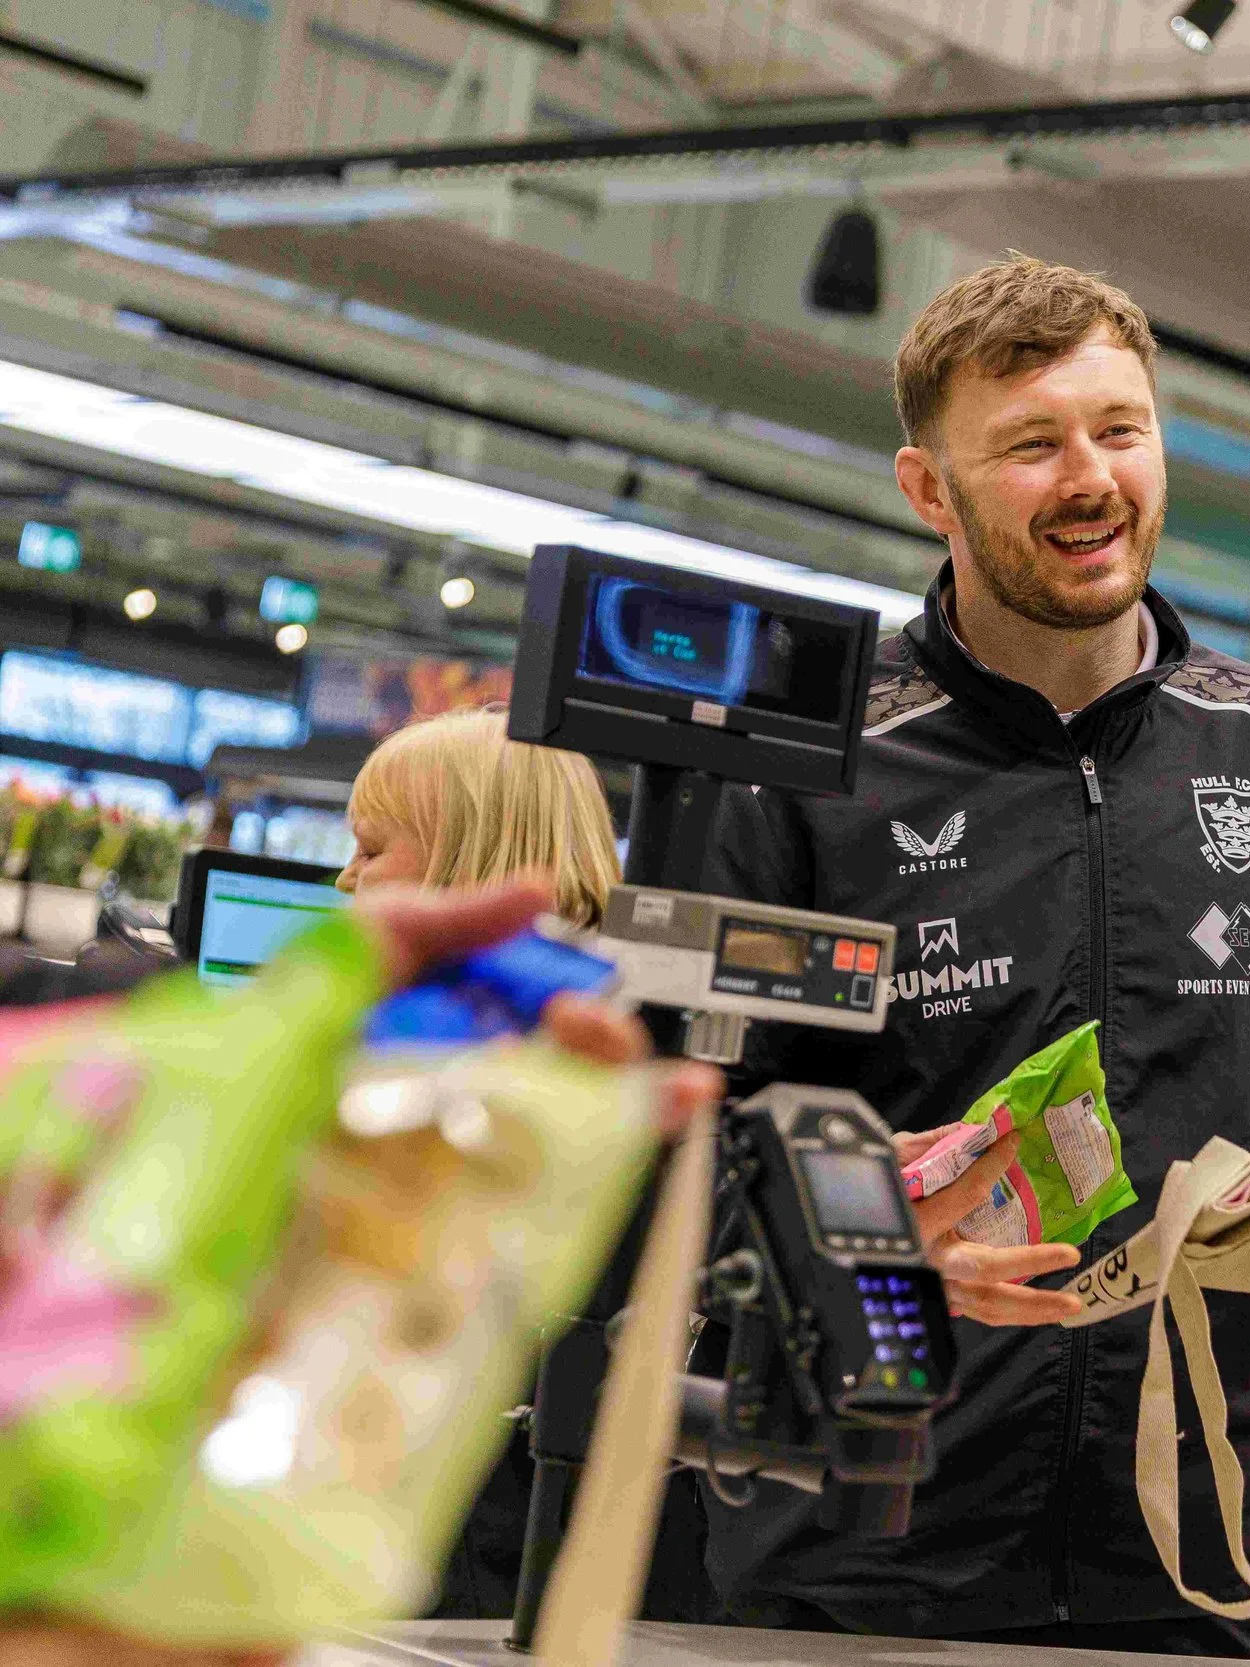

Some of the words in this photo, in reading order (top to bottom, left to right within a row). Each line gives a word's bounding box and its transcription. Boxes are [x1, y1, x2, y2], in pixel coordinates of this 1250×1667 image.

[1190, 775, 1231, 788] HULL
[899, 857, 968, 875] CASTORE
[1199, 843, 1221, 874] Est.
[1177, 979, 1223, 995] SPORTS
[922, 996, 973, 1019] DRIVE
